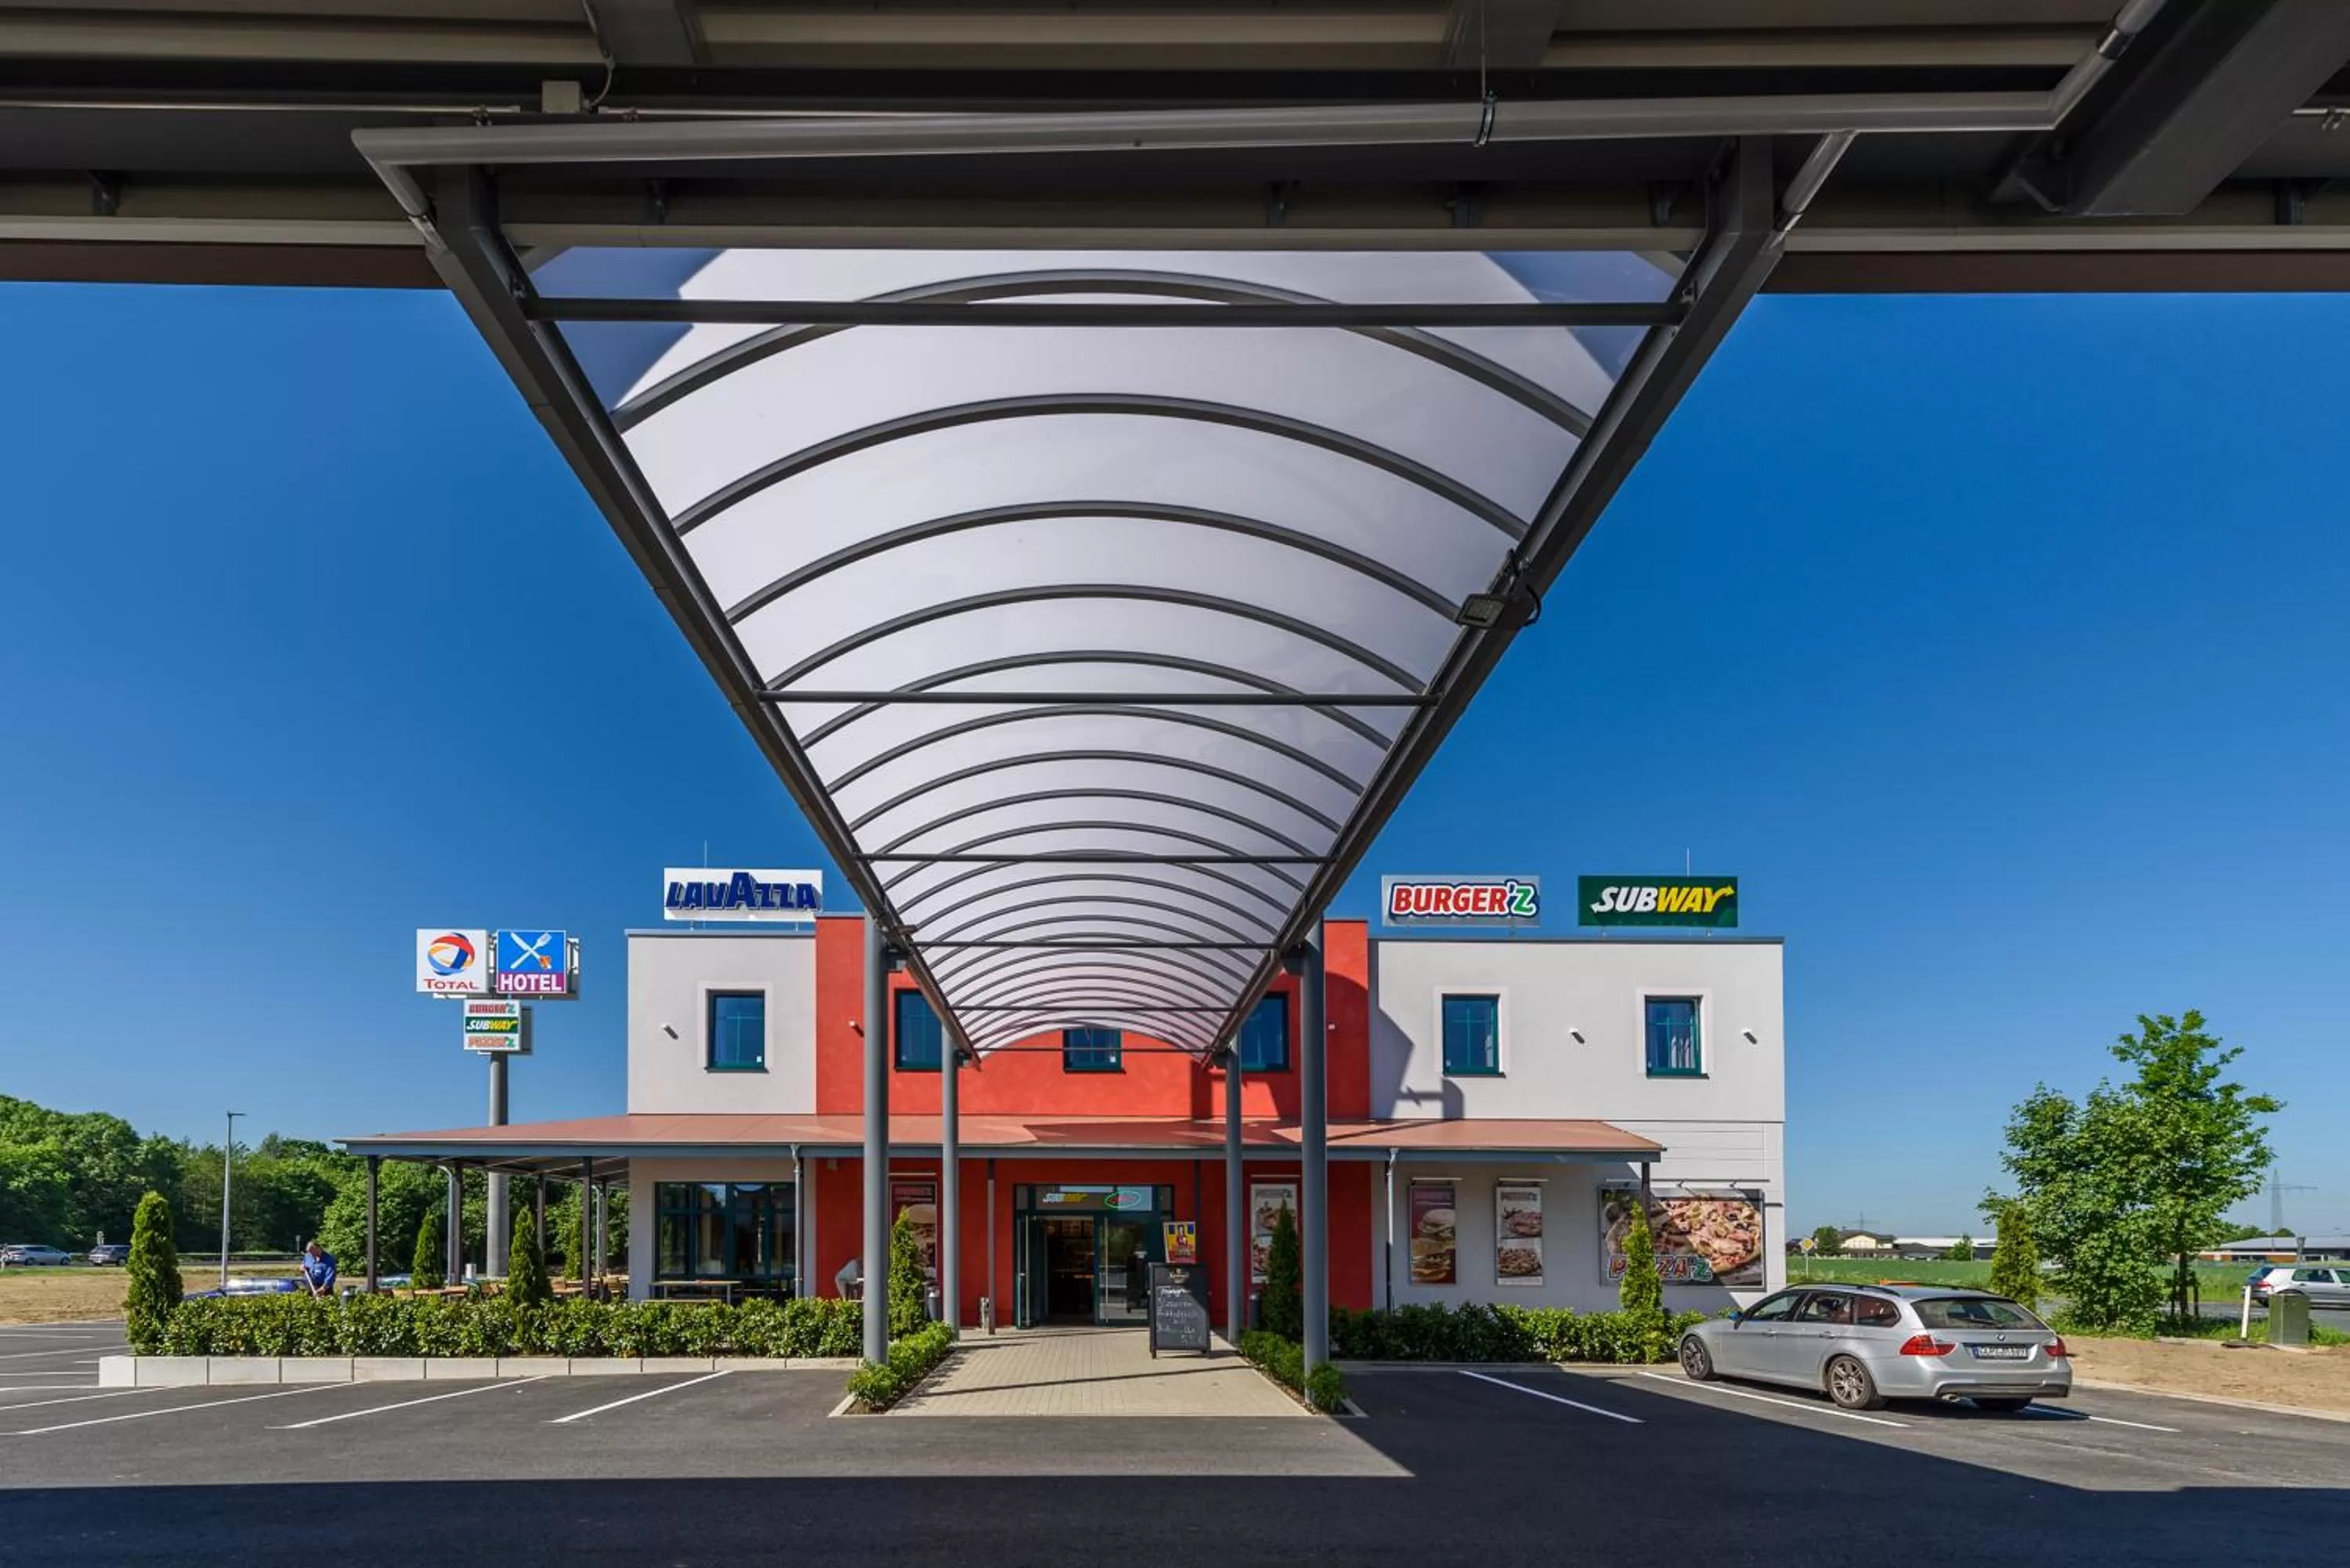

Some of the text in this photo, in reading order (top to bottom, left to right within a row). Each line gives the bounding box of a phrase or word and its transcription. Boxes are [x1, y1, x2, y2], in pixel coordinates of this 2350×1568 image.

[666, 872, 817, 909] LAVAZZA
[1390, 880, 1537, 916] BURGER'Z
[1590, 886, 1734, 913] SUBWAY
[423, 978, 479, 990] TOTAL
[500, 974, 562, 992] HOTEL
[466, 1019, 518, 1031] SUBWAY
[1608, 1255, 1712, 1281] PZA'Z
